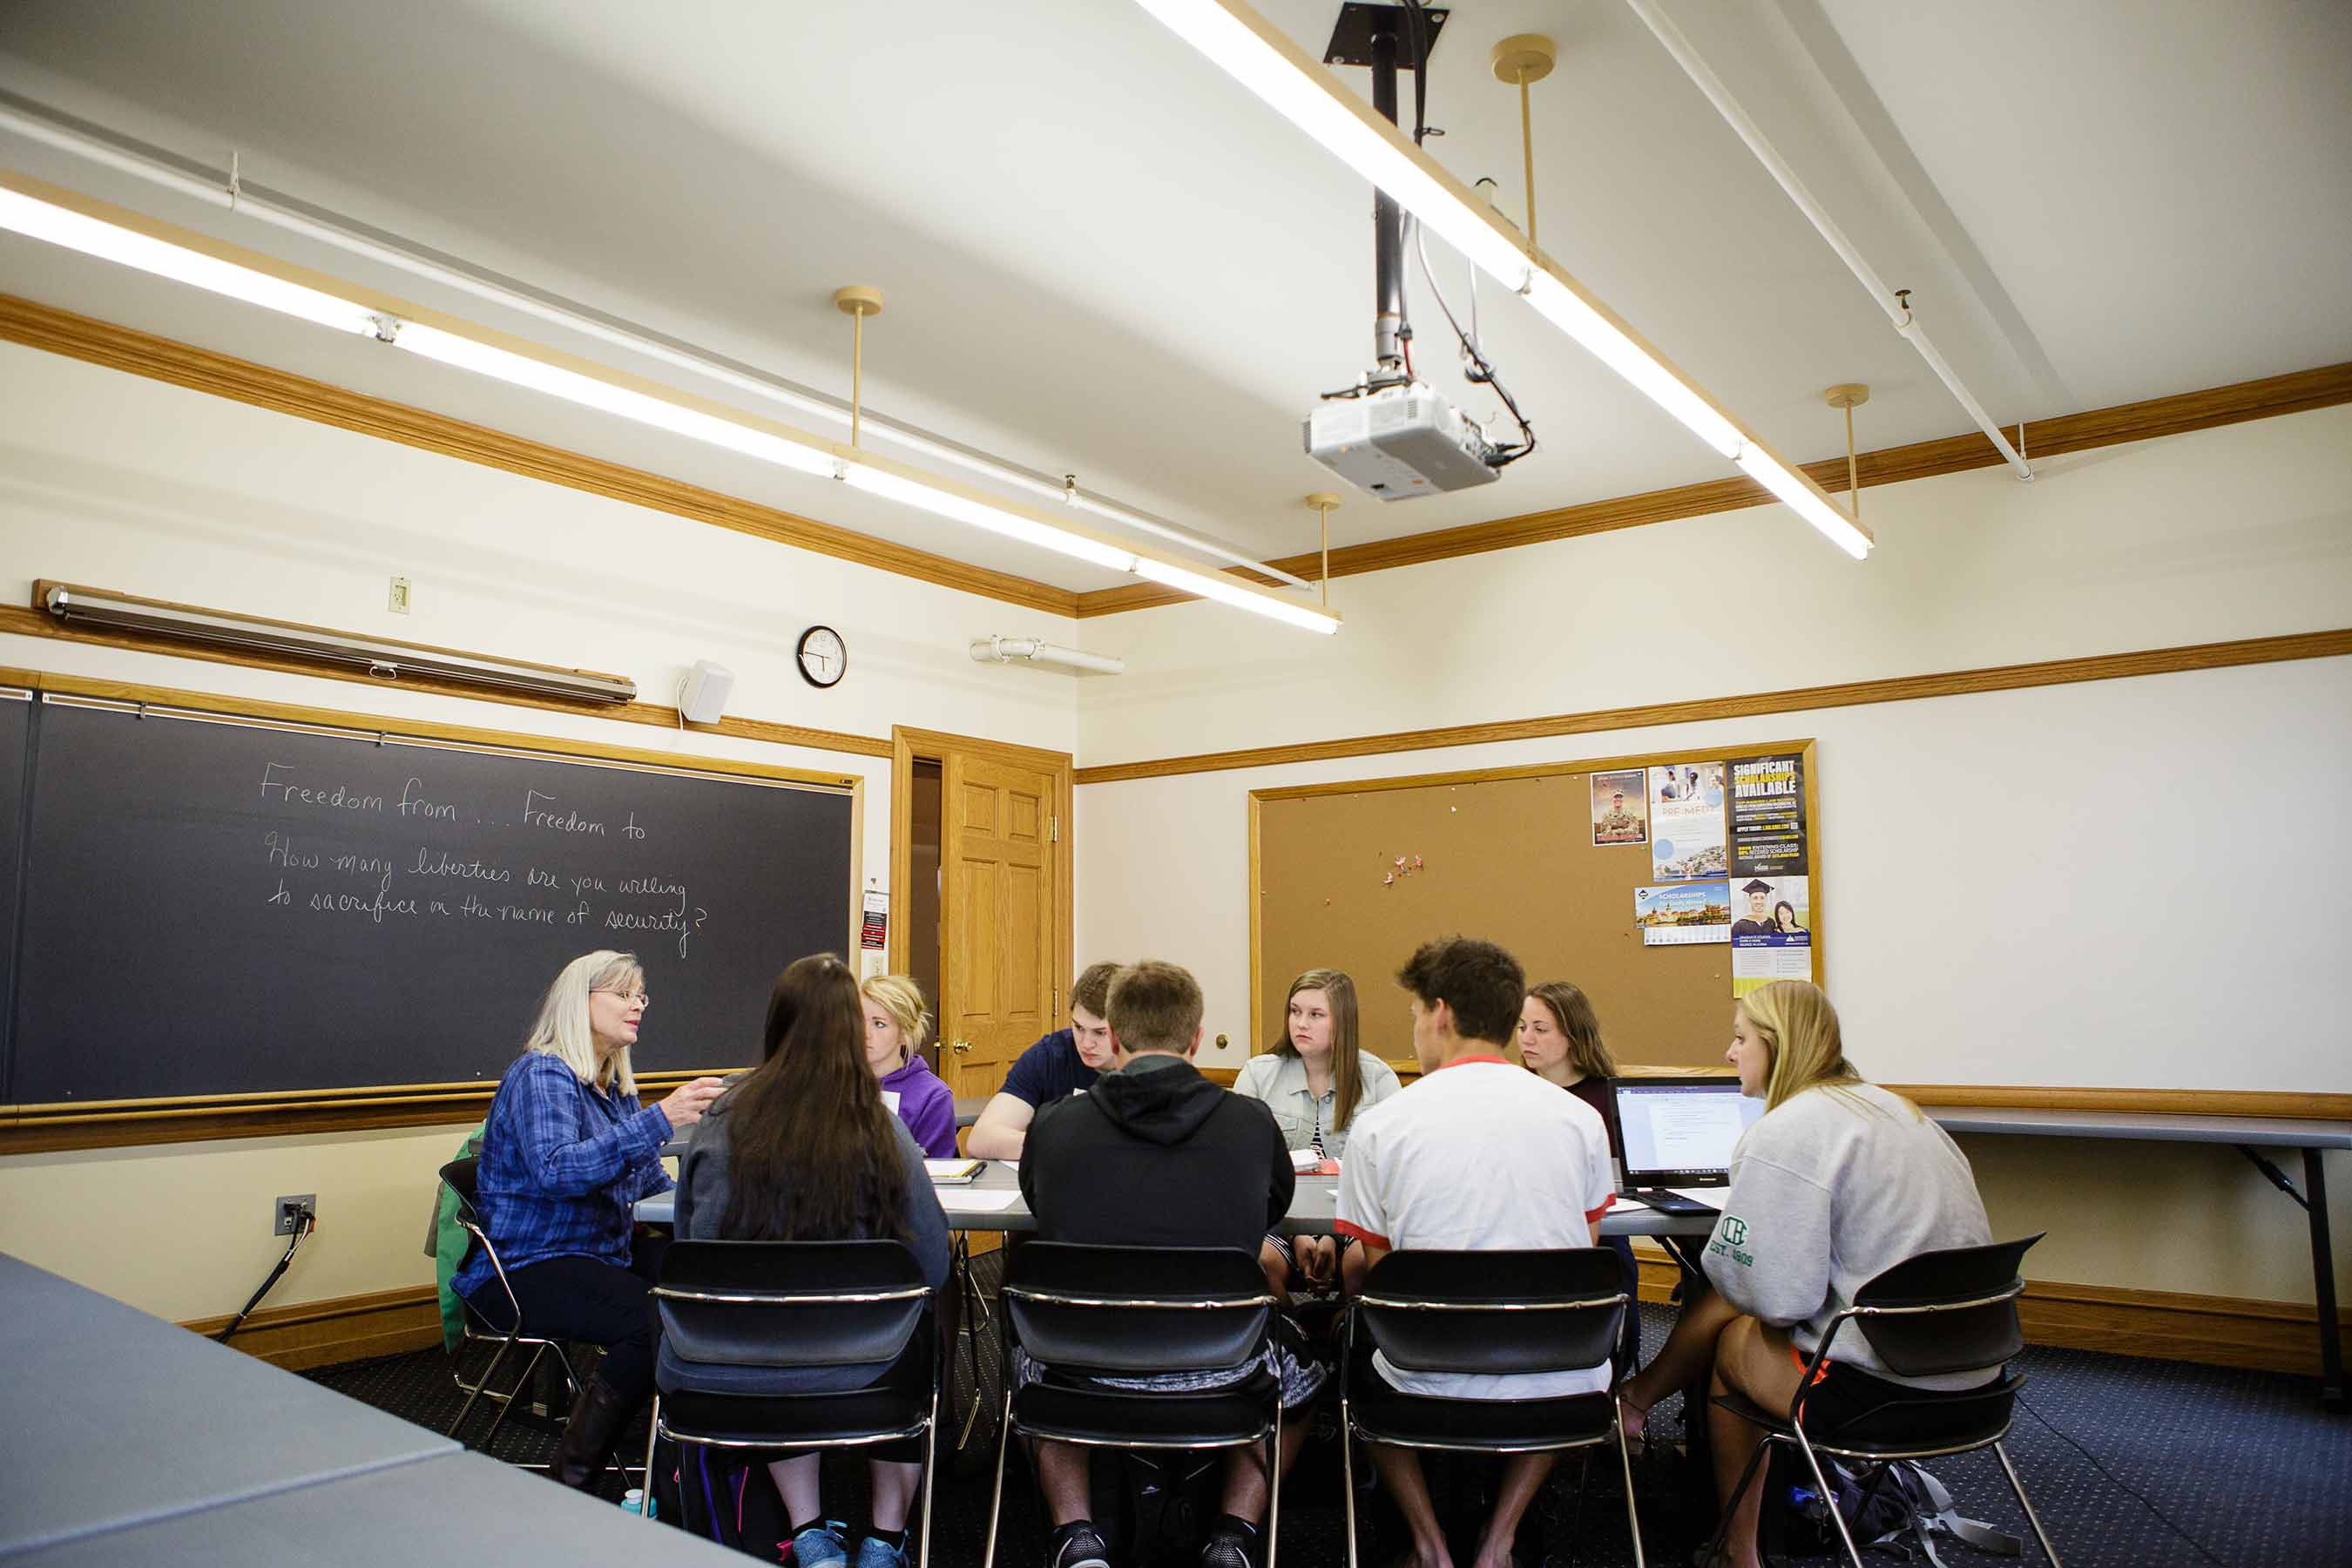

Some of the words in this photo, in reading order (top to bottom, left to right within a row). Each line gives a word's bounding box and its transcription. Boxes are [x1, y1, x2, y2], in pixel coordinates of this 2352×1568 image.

[1734, 760, 1794, 774] SIGNIFICANT
[1734, 772, 1796, 786] SCHOLARSHIPS
[260, 761, 383, 814] Freedom
[397, 777, 457, 822] from
[524, 788, 605, 837] Freedom
[622, 811, 646, 840] to
[1735, 781, 1796, 798] AVAILABLE
[264, 831, 320, 868] How
[329, 854, 393, 893] many
[408, 846, 510, 882] liberties
[528, 867, 564, 889] are
[571, 876, 607, 897] you
[619, 876, 687, 917] willing
[267, 877, 292, 906] to
[309, 891, 418, 923] sacrifice
[460, 894, 493, 919] the
[495, 904, 555, 925] name
[567, 900, 591, 925] of
